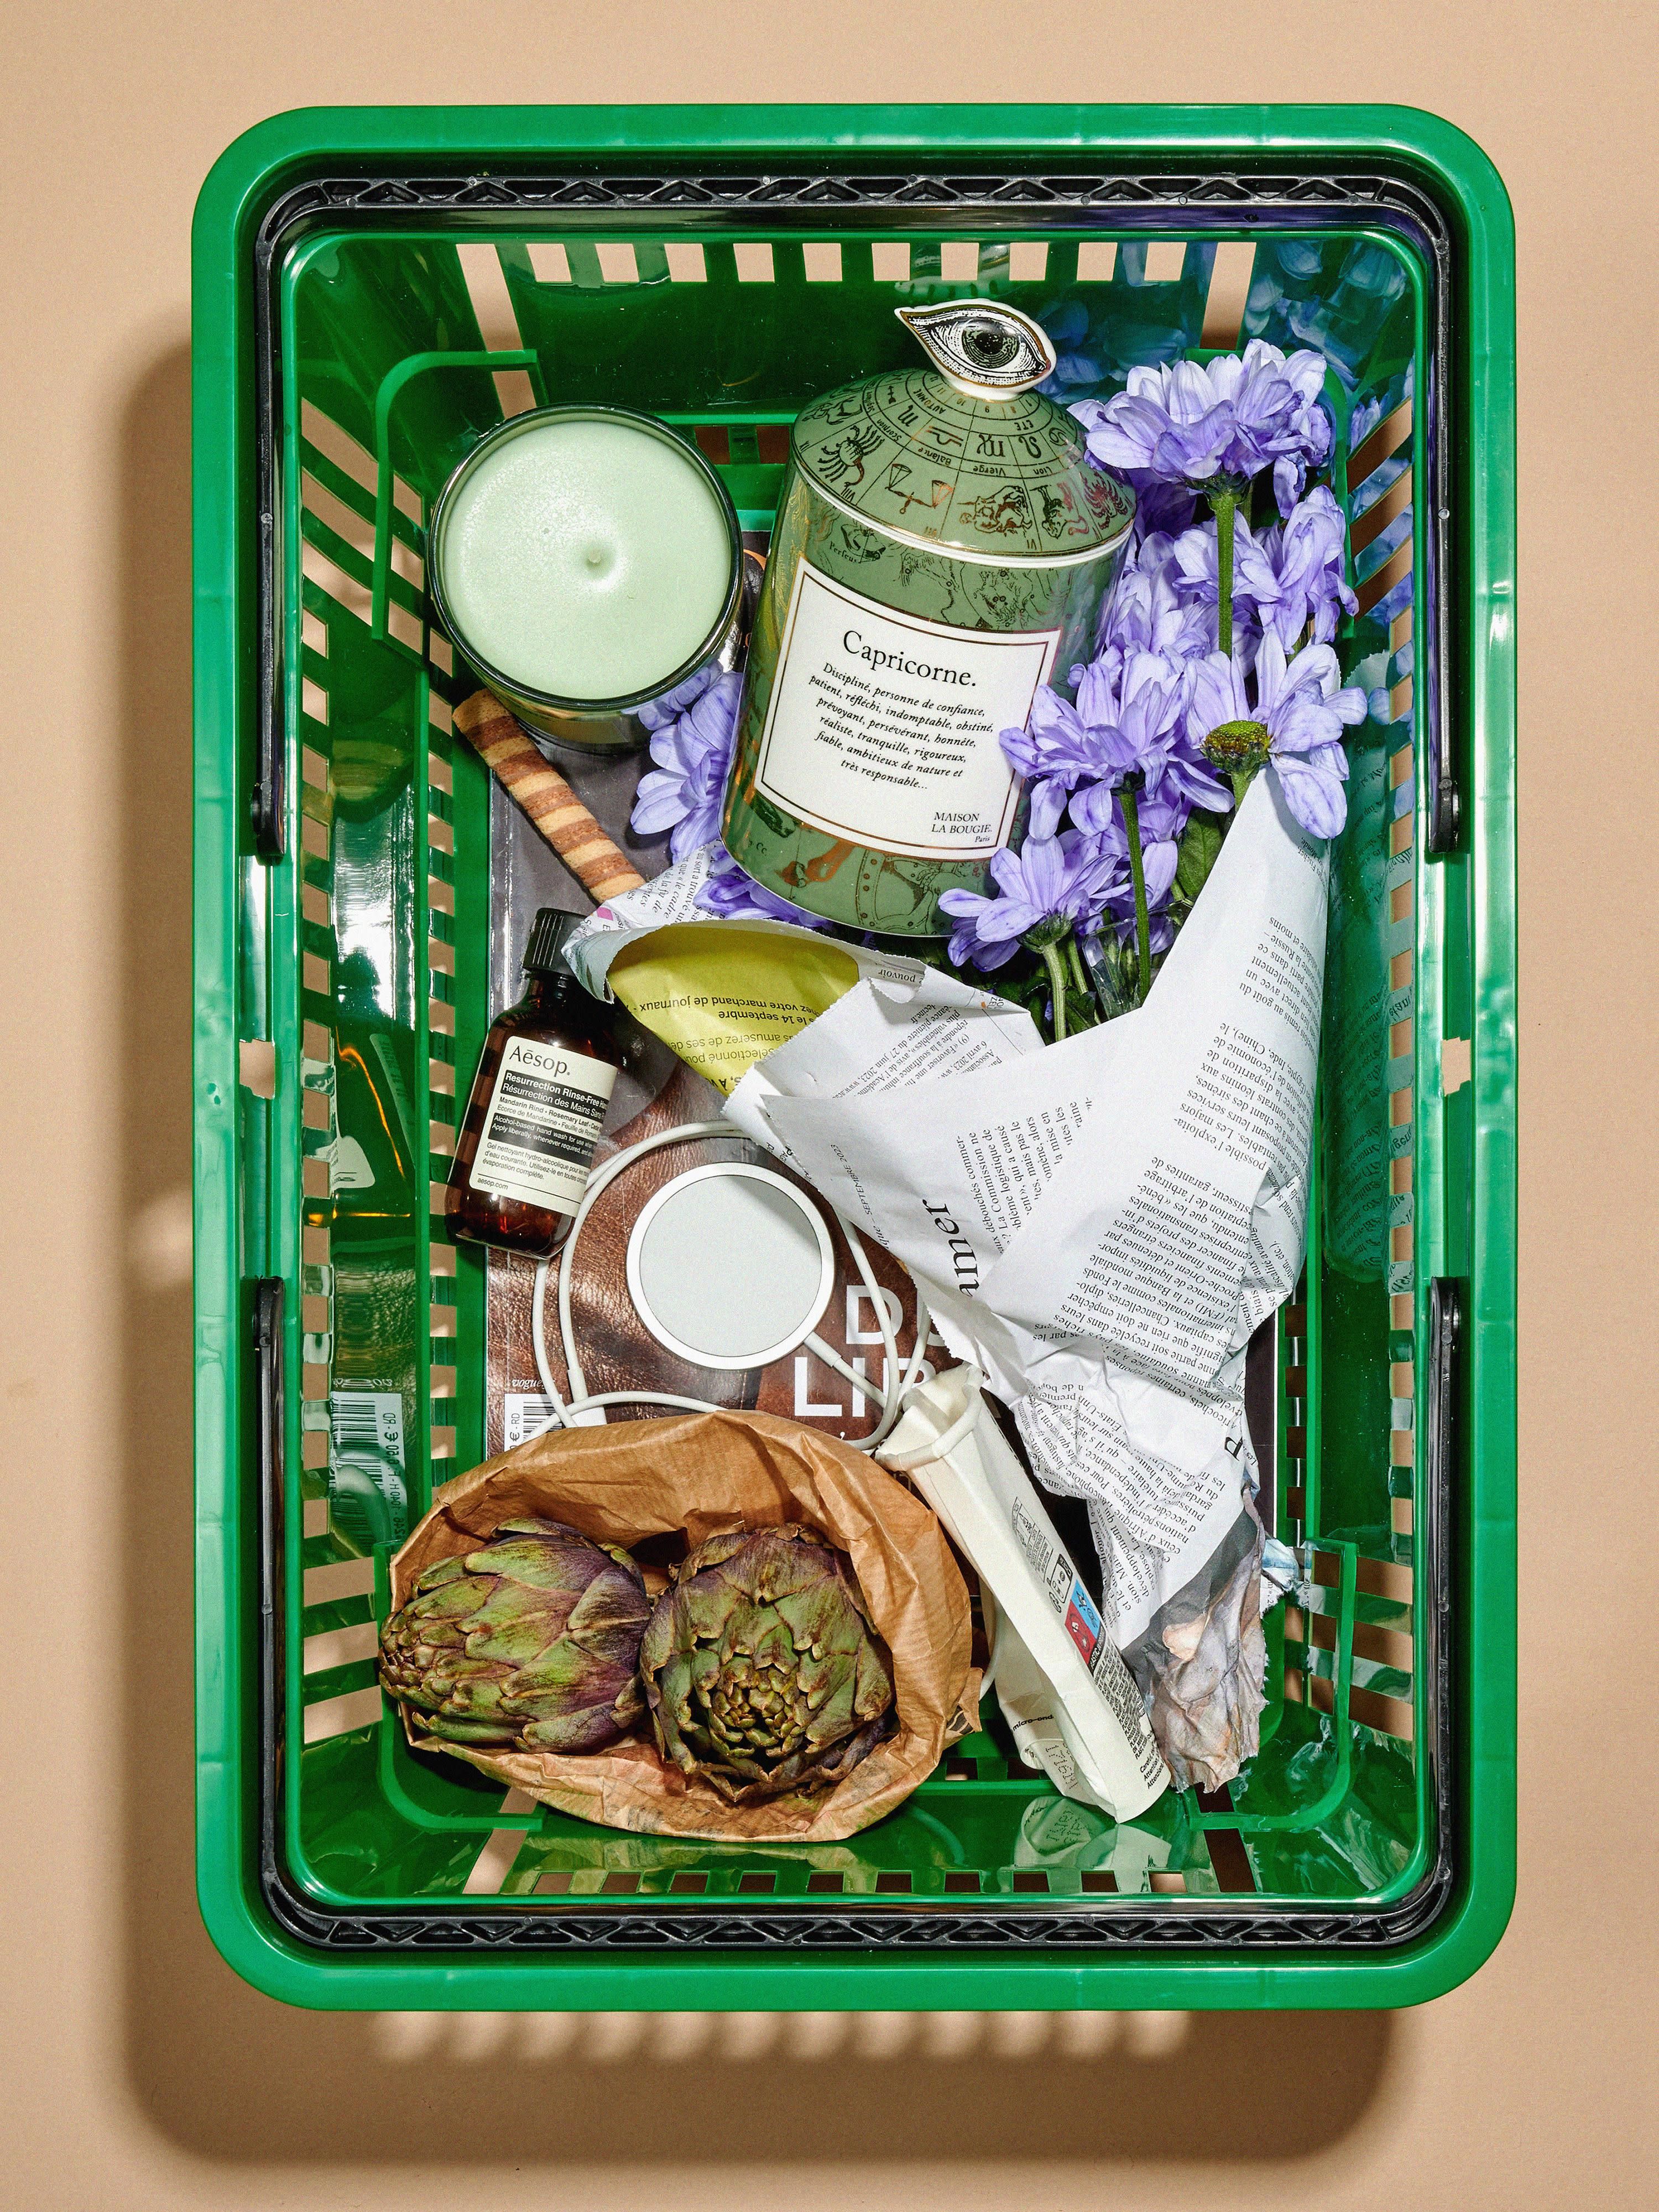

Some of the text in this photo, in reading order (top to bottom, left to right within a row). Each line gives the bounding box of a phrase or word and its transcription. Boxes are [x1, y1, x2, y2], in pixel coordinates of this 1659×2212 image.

[912, 388, 946, 414] AUTOMNE
[877, 419, 902, 443] Scorpion
[971, 463, 1006, 478] Vierge
[843, 630, 976, 687] Capricorne.
[823, 662, 985, 717] Discipliné, personne de confiance,
[808, 675, 993, 733] patient, réfléchi, indomptable, obstiné,
[816, 697, 976, 748] prévoyant, persévérant, honnête,
[820, 717, 966, 763] réaliste, tranquille, rigoureux,
[814, 731, 843, 751] fiable,
[847, 747, 899, 767] ambitieux
[901, 760, 914, 770] de
[916, 766, 951, 776] nature
[841, 760, 927, 789] très responsable...
[931, 823, 946, 833] LA
[934, 812, 979, 822] MAISON
[653, 900, 662, 913] de
[664, 891, 679, 919] cadre
[682, 881, 698, 911] trouvé
[1269, 917, 1293, 939] moins
[1271, 935, 1295, 961] Russie
[878, 969, 916, 983] pouvoir
[1251, 956, 1301, 998] actuellement
[1270, 951, 1305, 985] parti dans
[639, 995, 799, 1012] votre marchand de journaux
[1253, 990, 1274, 1007] goût
[1260, 978, 1300, 1016] direct avec
[718, 1011, 807, 1025] le 14 septembre
[907, 1017, 932, 1041] plénière
[686, 1031, 781, 1050] amuserez de ses
[890, 1047, 900, 1058] 27
[899, 1016, 968, 1078] répondre souffrance
[957, 1034, 969, 1045] (9)
[966, 1045, 982, 1060] avril
[1233, 1028, 1265, 1055] Chine),
[875, 1053, 891, 1068] juin
[1220, 1074, 1255, 1100] léonins
[1223, 1057, 1274, 1093] disparition
[502, 1083, 591, 1115] Résurrection des Mains
[505, 1072, 599, 1107] Resurrection Rinse-Free
[1187, 1089, 1226, 1115] services
[499, 1096, 589, 1127] Mandarin Rind Rosemary Leaf
[526, 1112, 558, 1126] Mandarine
[561, 1121, 578, 1132] Feuille
[1055, 1107, 1066, 1123] les
[1180, 1103, 1214, 1125] majors
[492, 1123, 508, 1133] Apply
[532, 1134, 561, 1146] whenever
[494, 1115, 568, 1140] Alcohol-based hand wash
[1026, 1117, 1040, 1141] alors
[1046, 1128, 1060, 1151] mise
[497, 1145, 524, 1157] nettoyant
[982, 1129, 1010, 1193] logistique de
[994, 1125, 1024, 1182] qui causé
[1016, 1133, 1036, 1176] mais pas
[1225, 1145, 1267, 1171] possible
[482, 1157, 544, 1180] évaporation complète.
[830, 1144, 873, 1215] SEPTEMBRE 2023
[969, 1133, 1001, 1213] Commission ne
[477, 1178, 508, 1190] aesop.com
[956, 1135, 995, 1233] débouchés commer-
[1129, 1196, 1198, 1235] transnationales
[1145, 1219, 1181, 1240] projets
[1113, 1219, 1205, 1269] financiers étrangers
[1121, 1238, 1164, 1262] détenues
[1083, 1267, 1112, 1286] Fonds
[1089, 1254, 1171, 1296] Banque mondiale
[1098, 1244, 1173, 1283] liquidités impor-
[1067, 1293, 1114, 1316] empêcher
[1107, 1292, 1170, 1326] Chancelleries,
[1110, 1327, 1170, 1355] soit recyclée
[509, 1413, 520, 1441] € RD
[1106, 1525, 1154, 1597] développement
